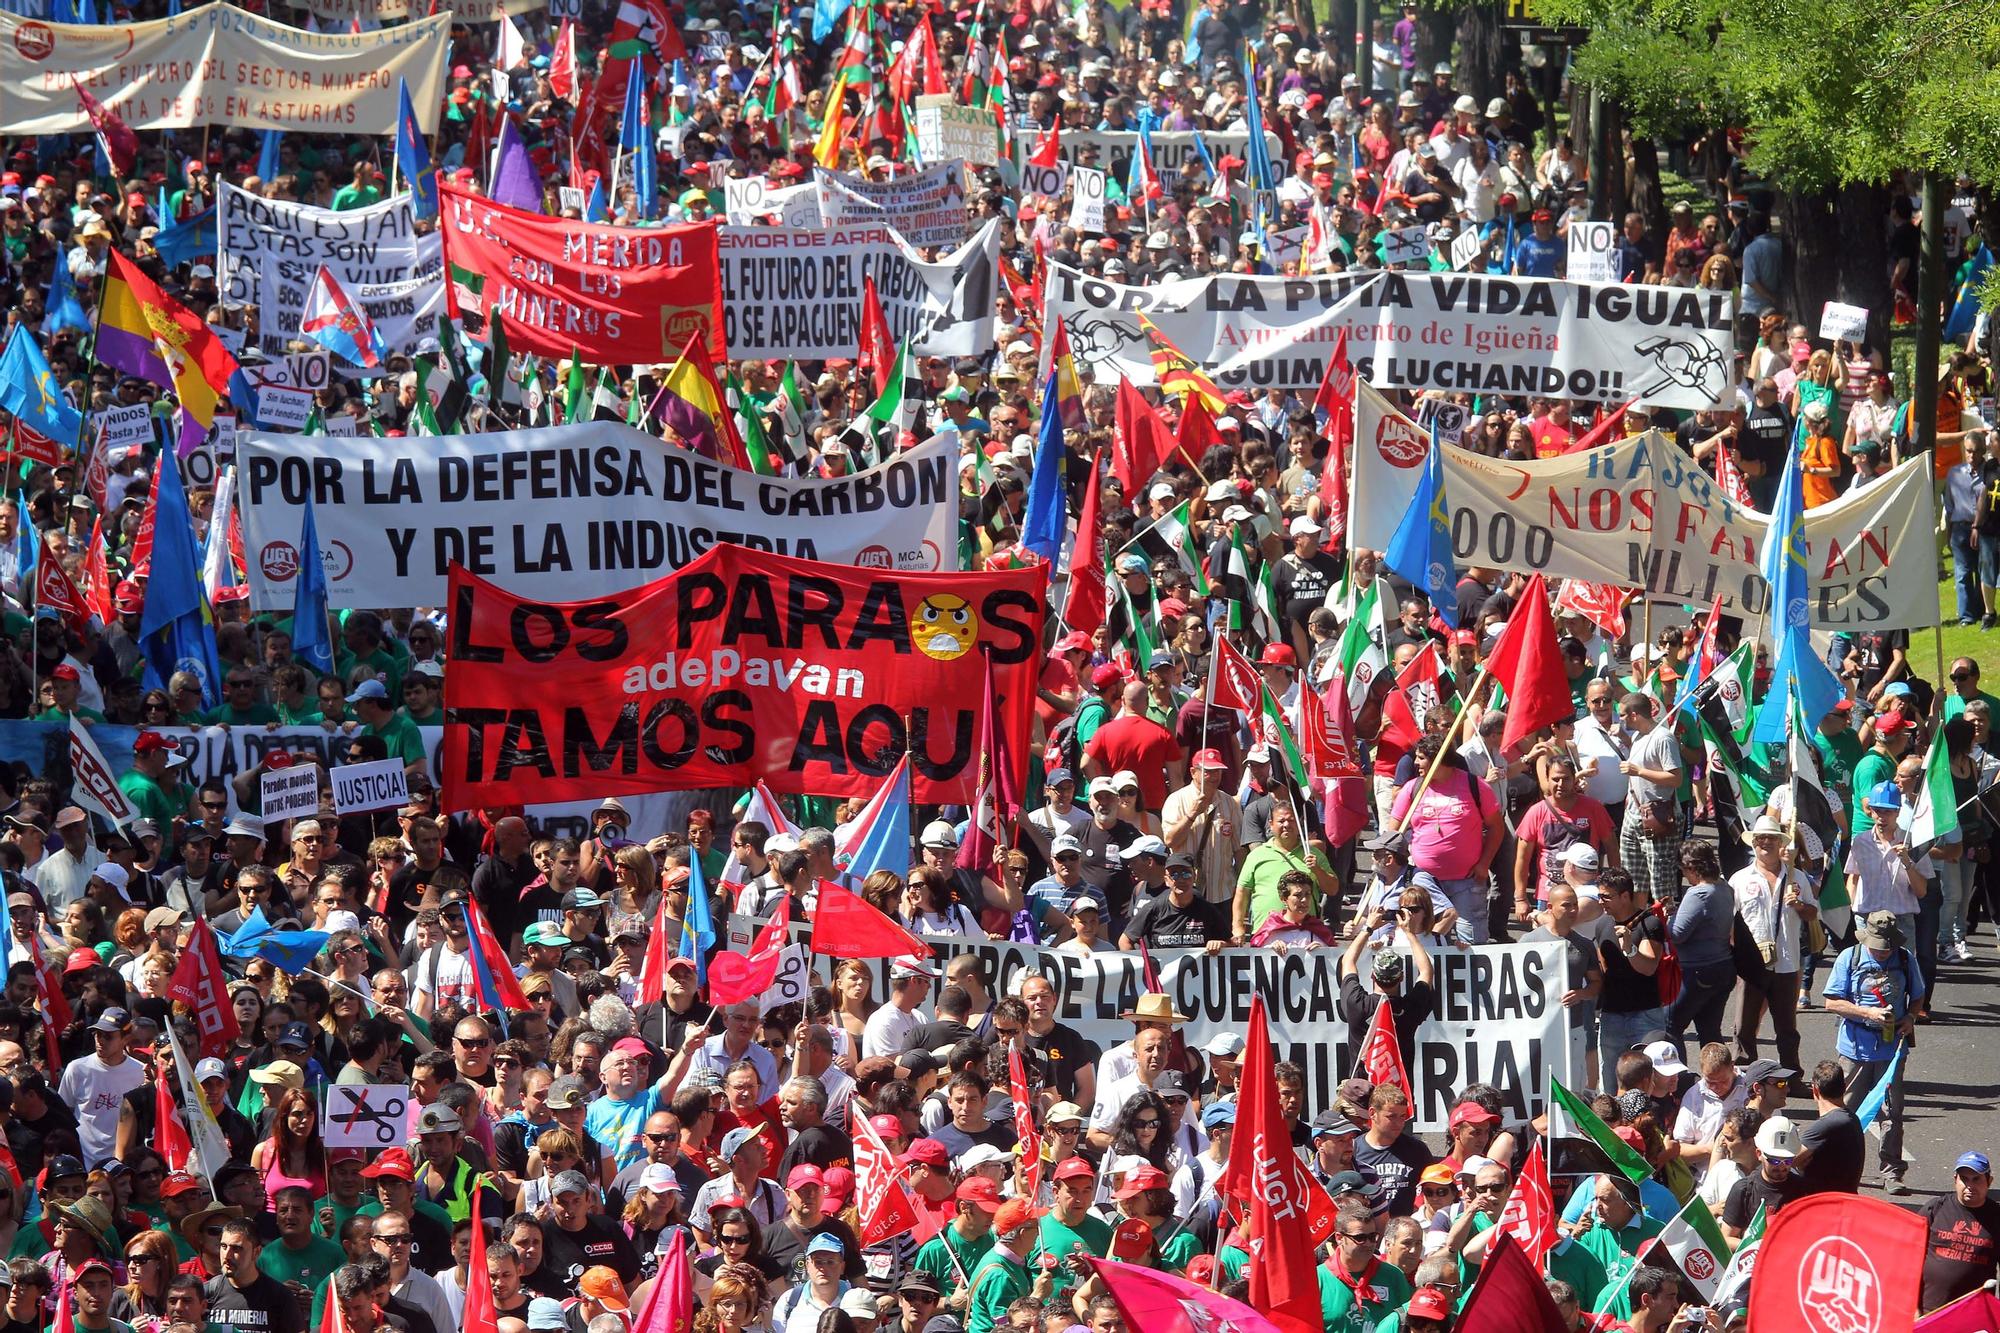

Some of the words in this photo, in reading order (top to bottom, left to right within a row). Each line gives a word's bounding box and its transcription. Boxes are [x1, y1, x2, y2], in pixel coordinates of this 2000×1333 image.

[267, 30, 361, 48] SANTIAGO
[90, 69, 109, 88] EL
[119, 60, 194, 85] FUTURO
[203, 59, 226, 81] DEL
[237, 62, 312, 90] SECTOR
[321, 69, 391, 91] MINERO
[76, 101, 150, 123] PNTA
[225, 96, 248, 117] EN
[260, 102, 356, 123] ASTURIAS
[944, 126, 971, 144] VIVA
[729, 183, 762, 210] NO
[1022, 166, 1060, 195] NO
[1076, 171, 1102, 198] NO
[227, 224, 314, 256] ESTAS
[322, 241, 377, 265] SON
[564, 231, 683, 268] MERIDA
[793, 231, 827, 247] DE
[1453, 232, 1477, 263] NO
[1571, 225, 1611, 252] NO
[580, 271, 622, 298] LOS
[740, 256, 818, 300] FUTURO
[823, 258, 857, 299] DEL
[497, 285, 622, 338] MINEROS
[1205, 278, 1267, 312] LA
[1285, 272, 1412, 312] PUTA
[1429, 276, 1558, 318] VIDA
[1576, 286, 1733, 331] IGUAL
[742, 307, 765, 348] SE
[770, 302, 860, 347] APAGUEN
[1216, 319, 1412, 352] Ayuamiento
[1420, 320, 1454, 346] de
[1464, 323, 1560, 354] Igüeña
[289, 357, 327, 387] NO
[1202, 358, 1375, 386] EGUIMS
[1386, 358, 1623, 399] LUCHANDO!!
[267, 392, 276, 402] Sin
[250, 456, 345, 505] POR
[363, 458, 423, 504] LA
[438, 446, 654, 502] DEFENSA
[663, 455, 745, 511] DEL
[759, 456, 947, 516] CARBON
[385, 528, 417, 577] Y
[434, 526, 496, 576] DE
[513, 523, 573, 573] LA
[588, 520, 818, 571] INDUS
[1548, 486, 1656, 533] NOS
[1675, 503, 1889, 580] FAAN
[266, 549, 294, 567] UGT
[859, 551, 889, 567] UGT
[898, 551, 924, 562] MCA
[898, 562, 929, 570] Asturias
[1626, 542, 1891, 624] MILLOES
[452, 584, 629, 663] LOS
[446, 690, 755, 784] TAMOS
[788, 694, 1006, 782] AQU
[207, 735, 239, 778] LA
[338, 771, 406, 807] JUSTICIA!
[1373, 950, 1546, 1022] INERAS
[1095, 1103, 1102, 1118] 3
[1811, 1250, 1872, 1310] UGT
[215, 1310, 226, 1323] LA
[228, 1310, 268, 1325] MINERIA
